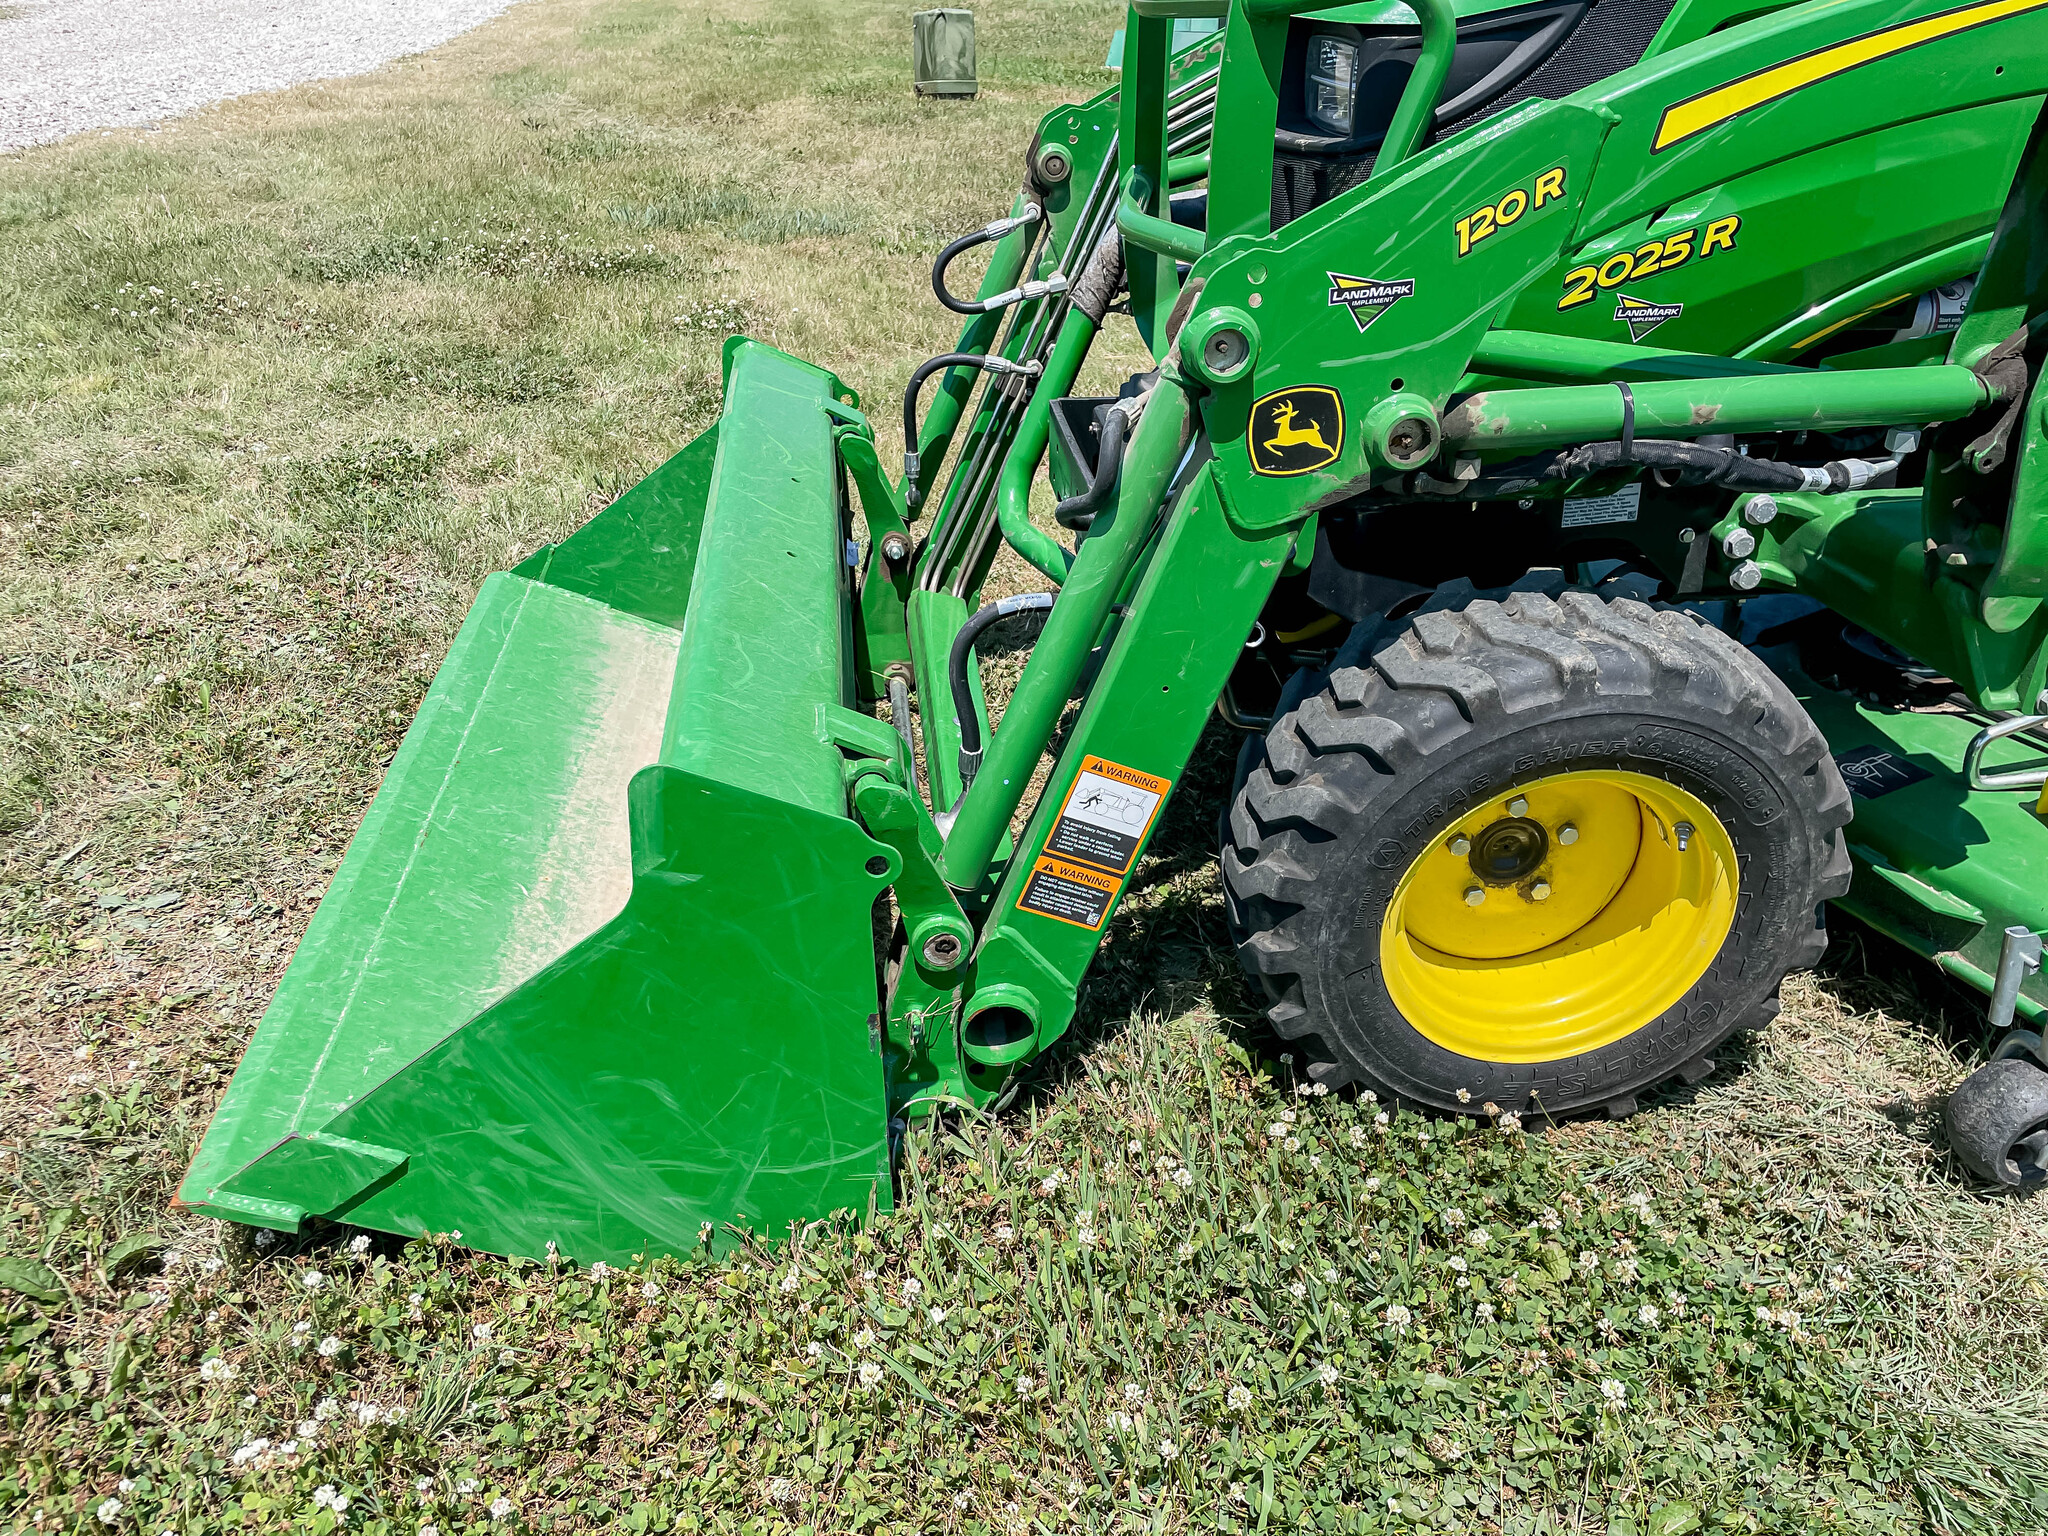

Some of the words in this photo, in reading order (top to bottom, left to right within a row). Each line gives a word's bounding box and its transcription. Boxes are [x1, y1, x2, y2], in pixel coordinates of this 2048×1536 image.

[1455, 189, 1529, 258] 120
[1533, 166, 1567, 211] R
[1557, 228, 1698, 311] 2025
[1700, 214, 1743, 258] R
[1351, 296, 1394, 306] IMPLEMENT
[1106, 765, 1159, 789] WARNING
[1404, 772, 1491, 838] TRAC
[1512, 740, 1628, 774] CHIEF
[1059, 866, 1111, 888] WARNING
